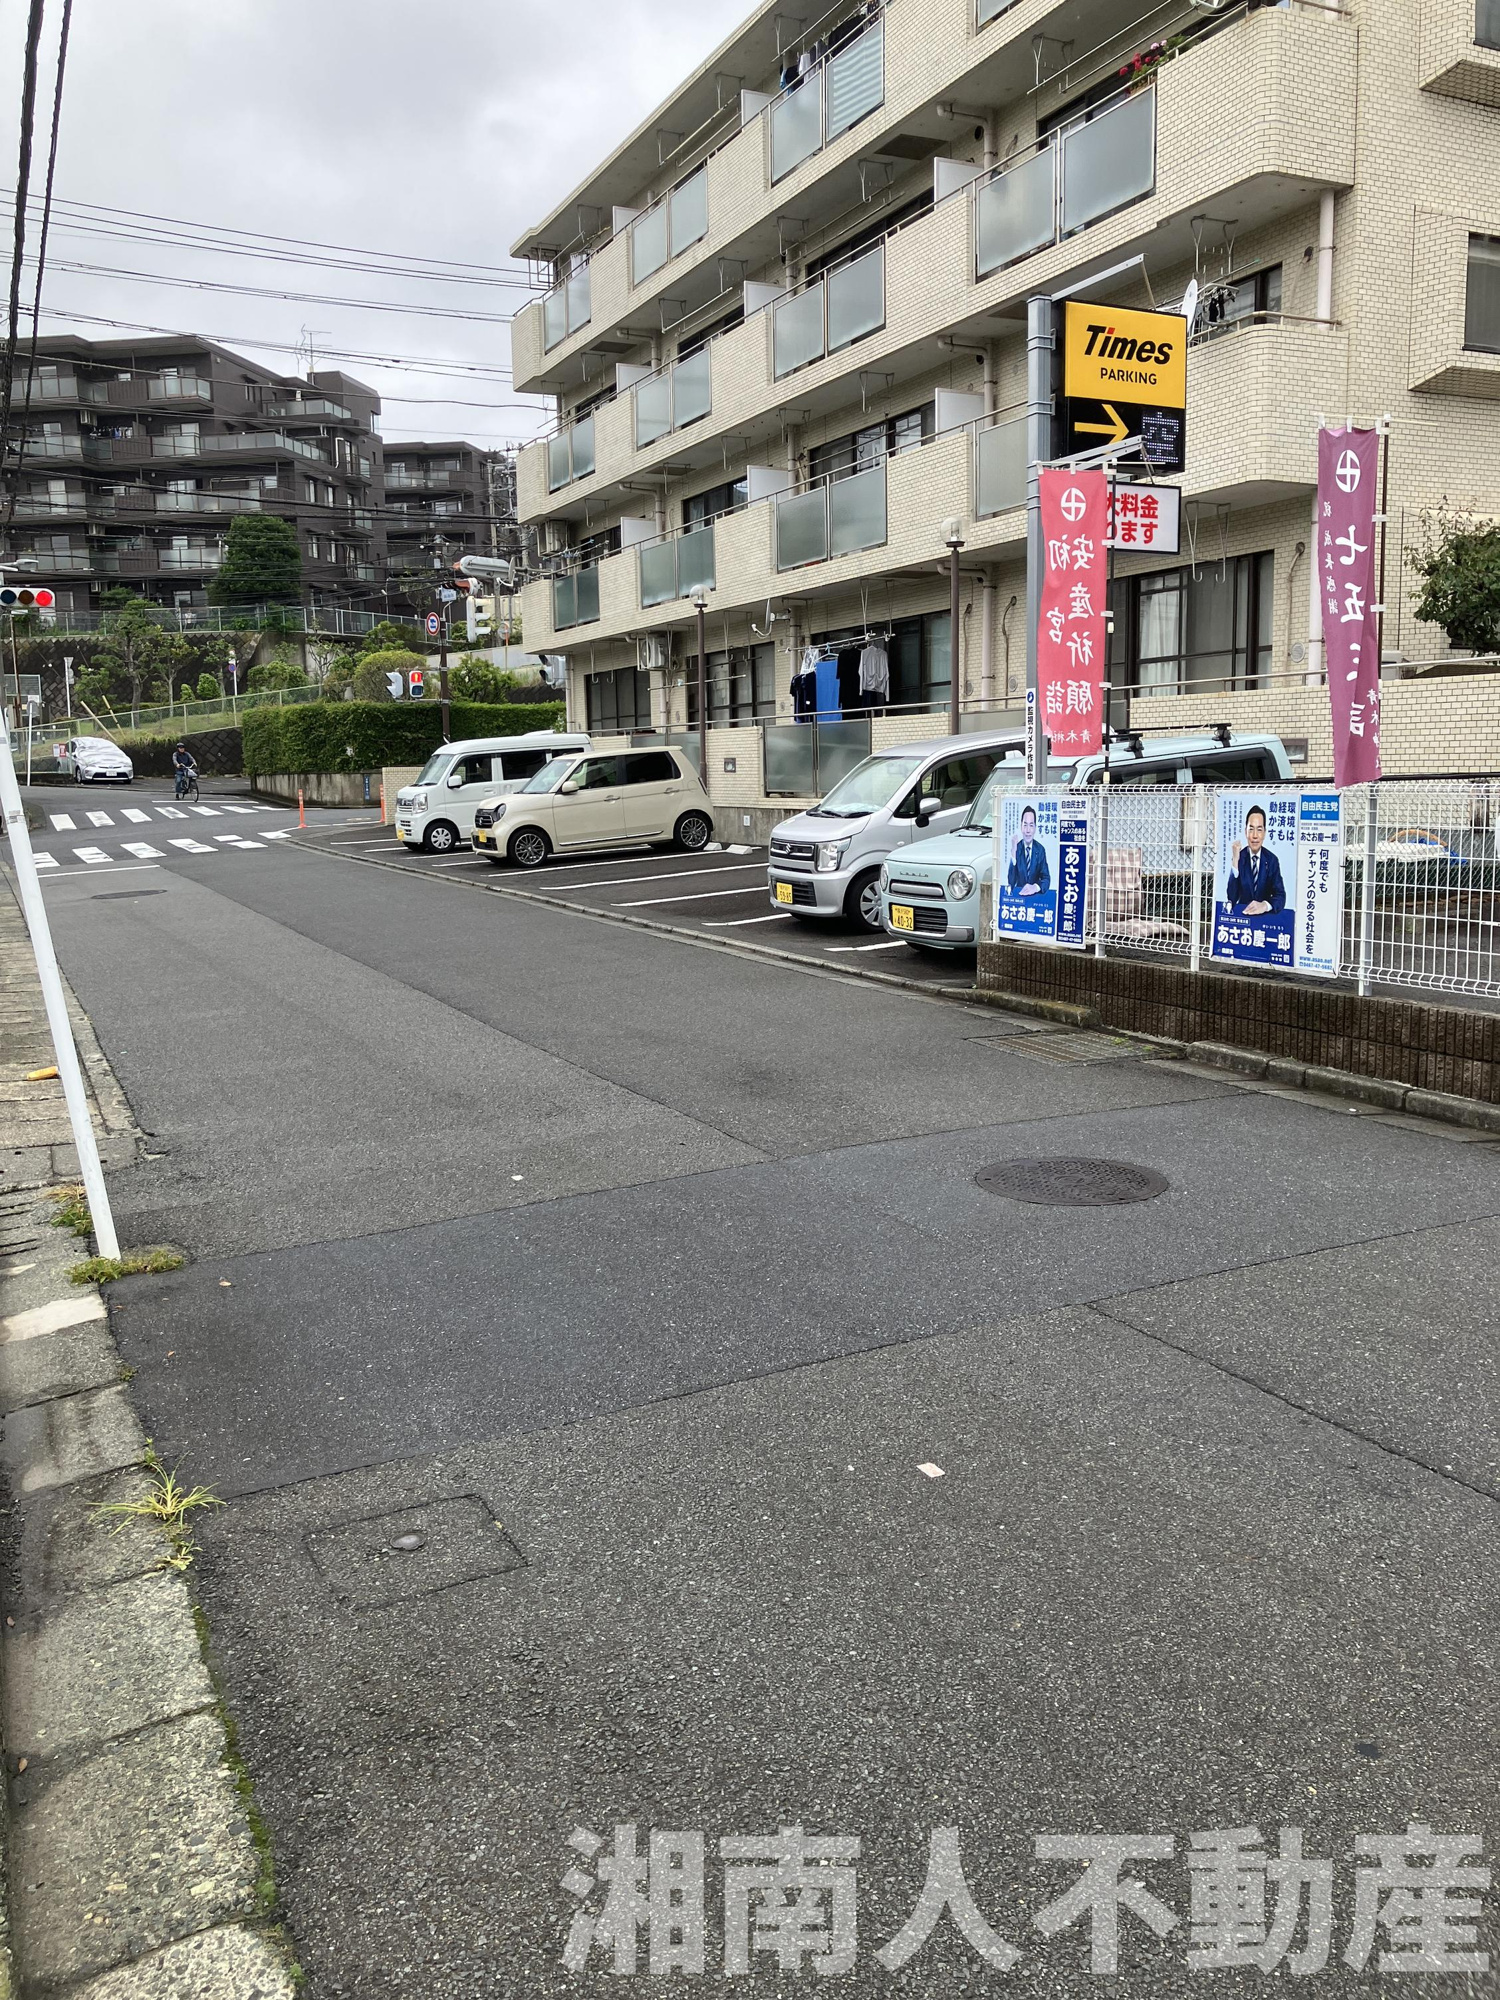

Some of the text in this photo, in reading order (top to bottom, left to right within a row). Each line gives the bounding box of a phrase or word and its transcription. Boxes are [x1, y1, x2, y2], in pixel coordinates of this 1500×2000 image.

[1084, 324, 1173, 365] Times
[1100, 367, 1157, 385] PARKING
[1268, 801, 1278, 846] 動かす。
[1277, 801, 1287, 841] 経済も
[1286, 801, 1296, 846] 環境は、
[1301, 801, 1339, 812] 自由民主党
[1300, 832, 1339, 842] あさお慶一郎
[1063, 847, 1079, 931] あさお慶一郎
[1319, 849, 1329, 893] 何度でも
[1001, 904, 1054, 924] あさお慶一郎
[1305, 849, 1317, 955] チャンスのある社会を
[1217, 924, 1291, 951] あさお慶一郎
